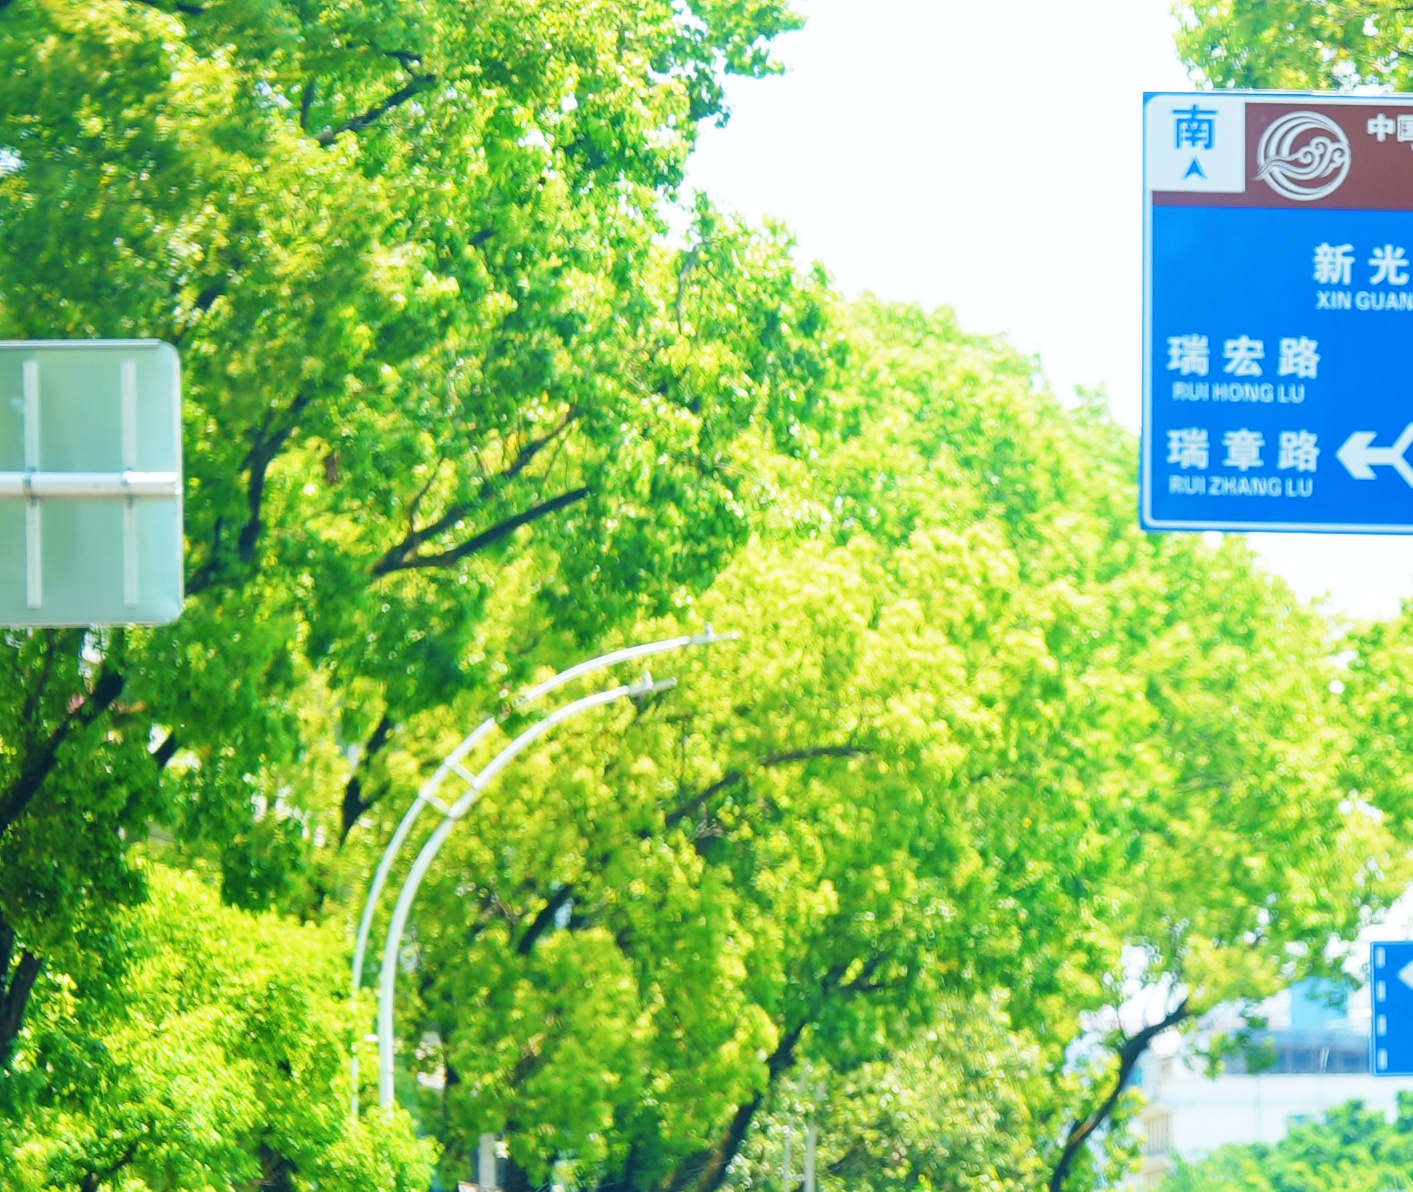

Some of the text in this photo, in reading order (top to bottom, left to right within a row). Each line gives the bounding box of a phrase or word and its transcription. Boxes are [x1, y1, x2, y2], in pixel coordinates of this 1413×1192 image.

[1172, 104, 1218, 150] 南
[1316, 290, 1352, 310] XIN
[1166, 333, 1321, 379] 瑞宏路
[1172, 381, 1305, 403] RUI HONG LU
[1166, 426, 1321, 472] 瑞章路
[1168, 474, 1314, 497] RUI ZHANG LU
